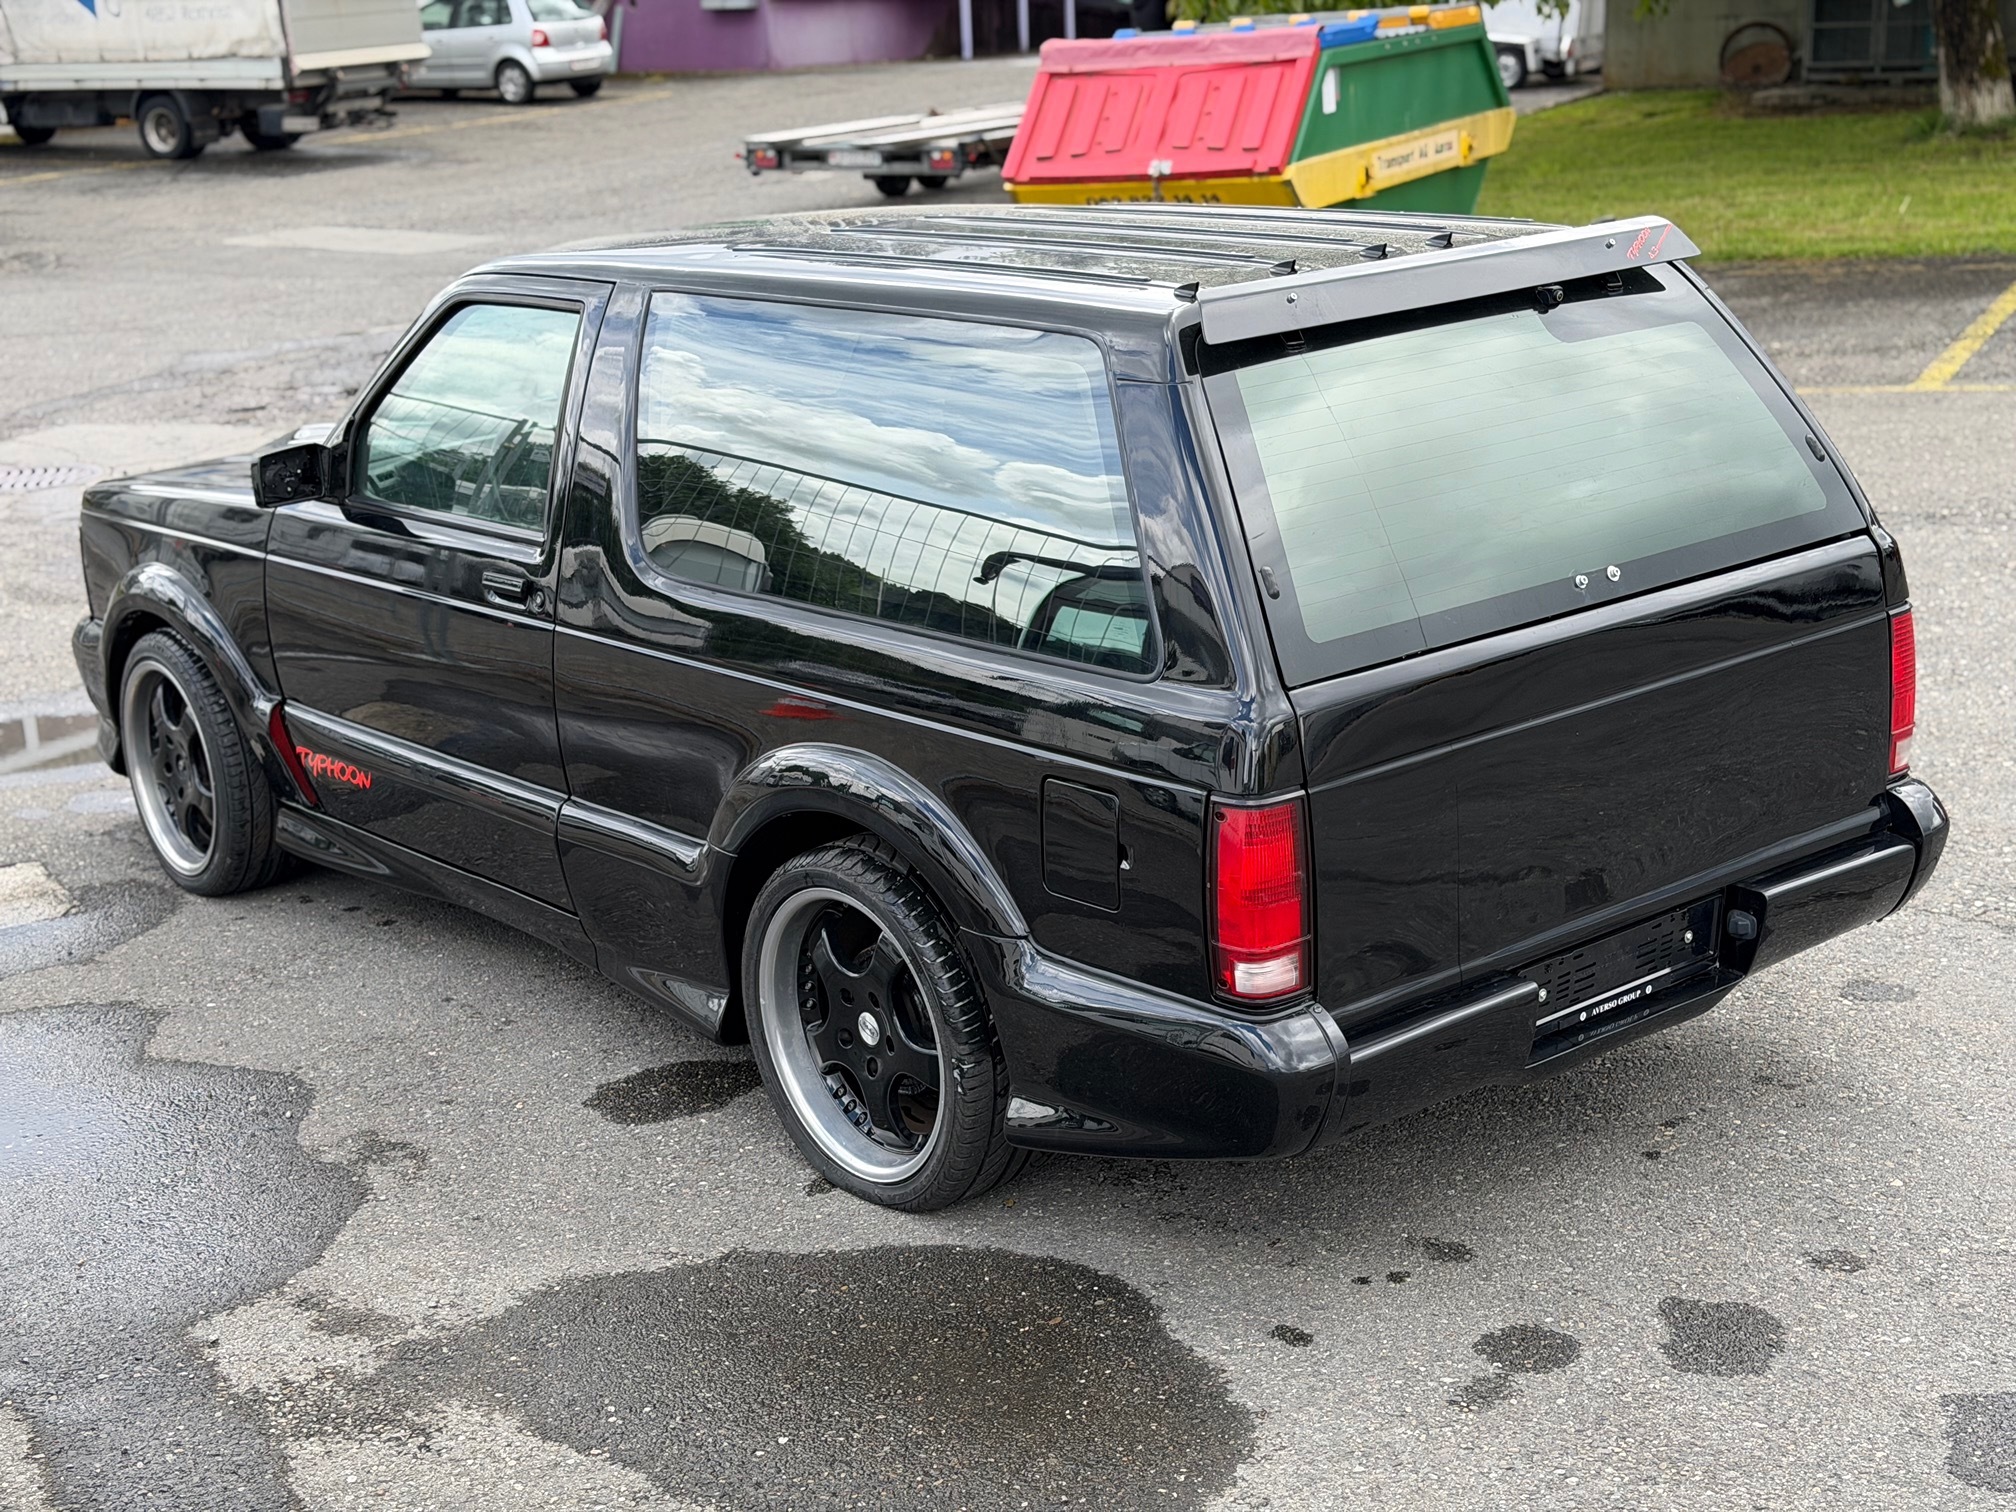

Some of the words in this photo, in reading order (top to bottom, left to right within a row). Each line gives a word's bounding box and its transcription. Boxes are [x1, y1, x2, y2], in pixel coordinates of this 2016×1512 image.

[296, 746, 372, 789] TYPHOON
[1591, 999, 1617, 1017] AVERSO
[1618, 989, 1641, 1005] GROUP
